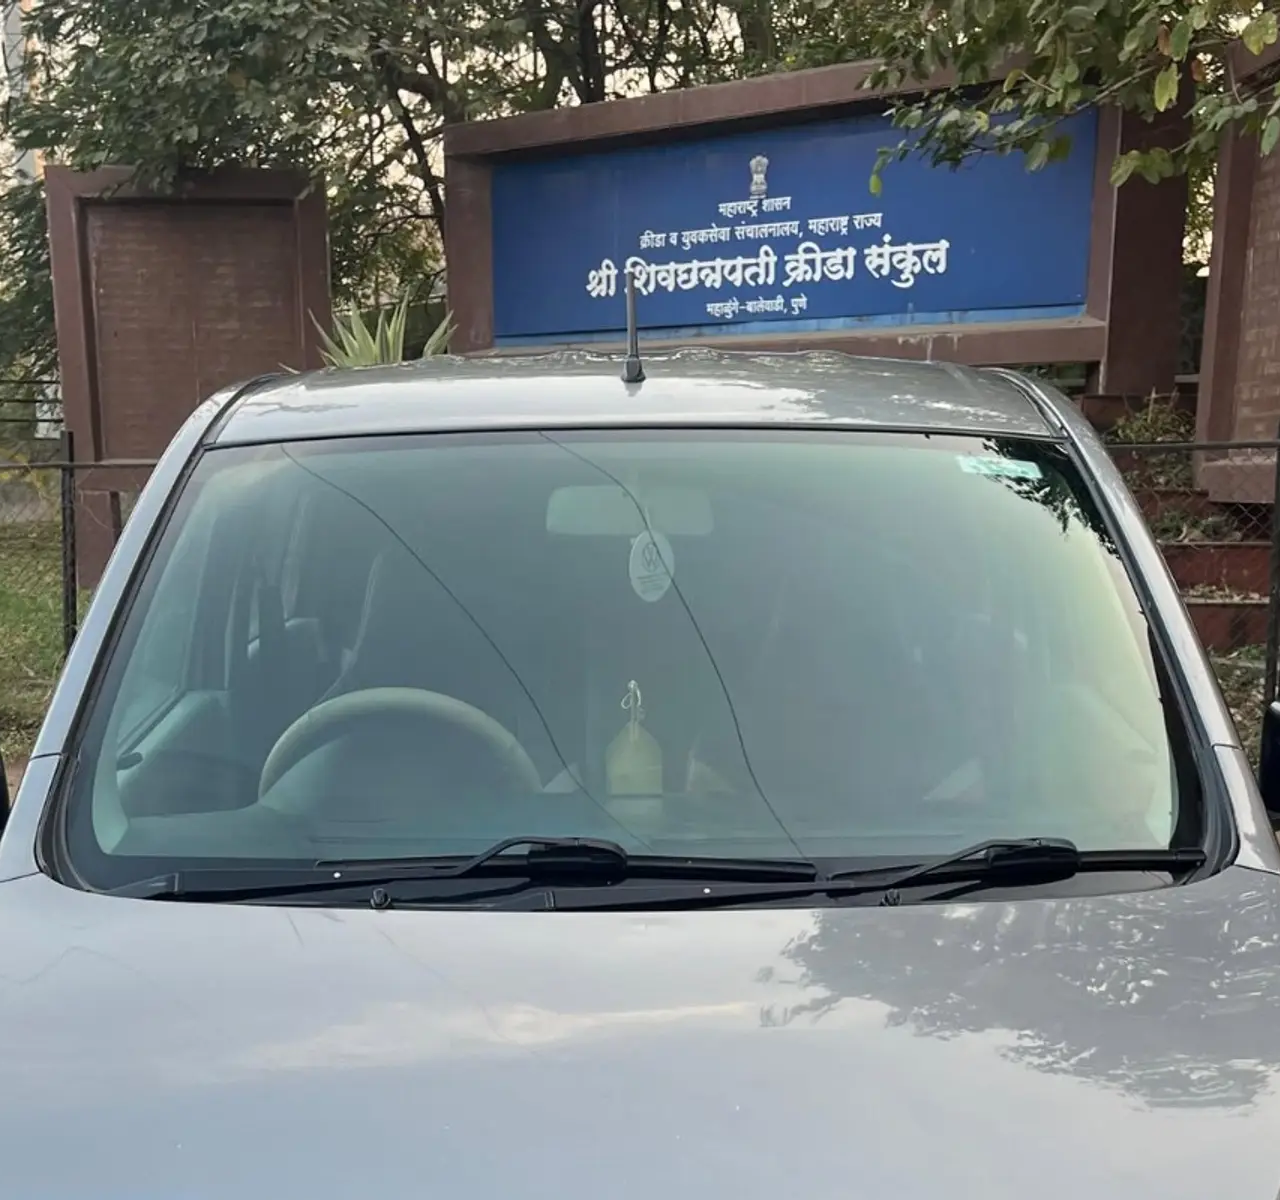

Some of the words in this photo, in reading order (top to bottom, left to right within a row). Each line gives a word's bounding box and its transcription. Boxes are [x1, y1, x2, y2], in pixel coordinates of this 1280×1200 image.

[718, 200, 759, 218] महाराष्ट्र
[761, 196, 792, 212] शासन
[639, 230, 667, 250] क्रीडा
[669, 232, 679, 246] व
[681, 222, 732, 251] युवकसेवा
[734, 220, 803, 240] संचालनालय,
[808, 215, 850, 236] महाराष्ट्र
[852, 213, 883, 230] राज्य
[586, 258, 618, 298] श्री
[782, 241, 857, 287] क्रीडा
[864, 233, 950, 289] संकुल
[791, 292, 808, 315] पुणे
